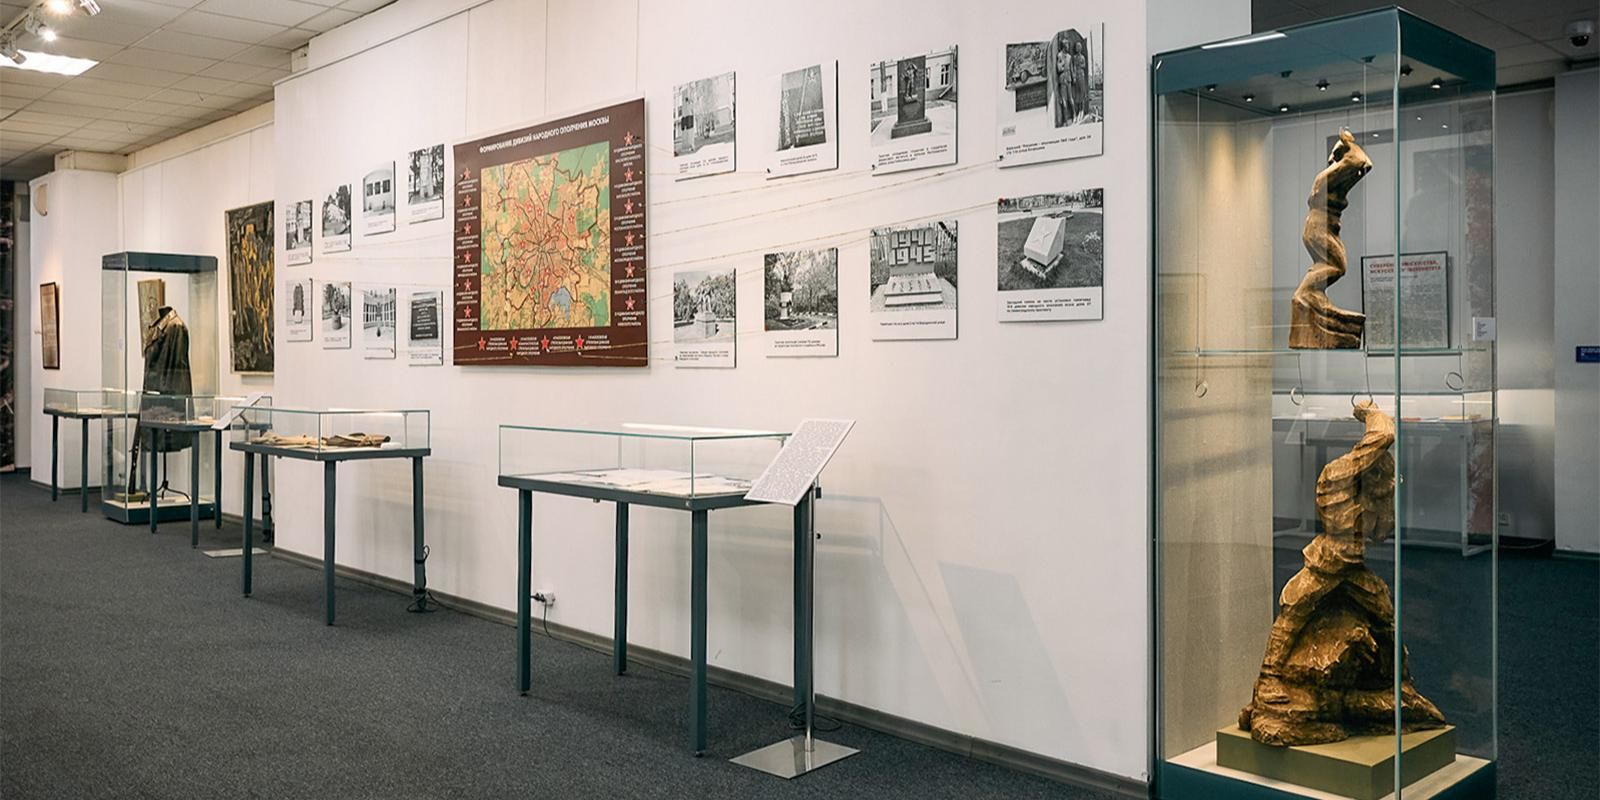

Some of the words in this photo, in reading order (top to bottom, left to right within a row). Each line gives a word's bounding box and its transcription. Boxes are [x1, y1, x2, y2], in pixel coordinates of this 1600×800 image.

[588, 115, 610, 128] МОСКВЫ
[891, 228, 936, 249] 1941
[889, 246, 936, 266] 1945
